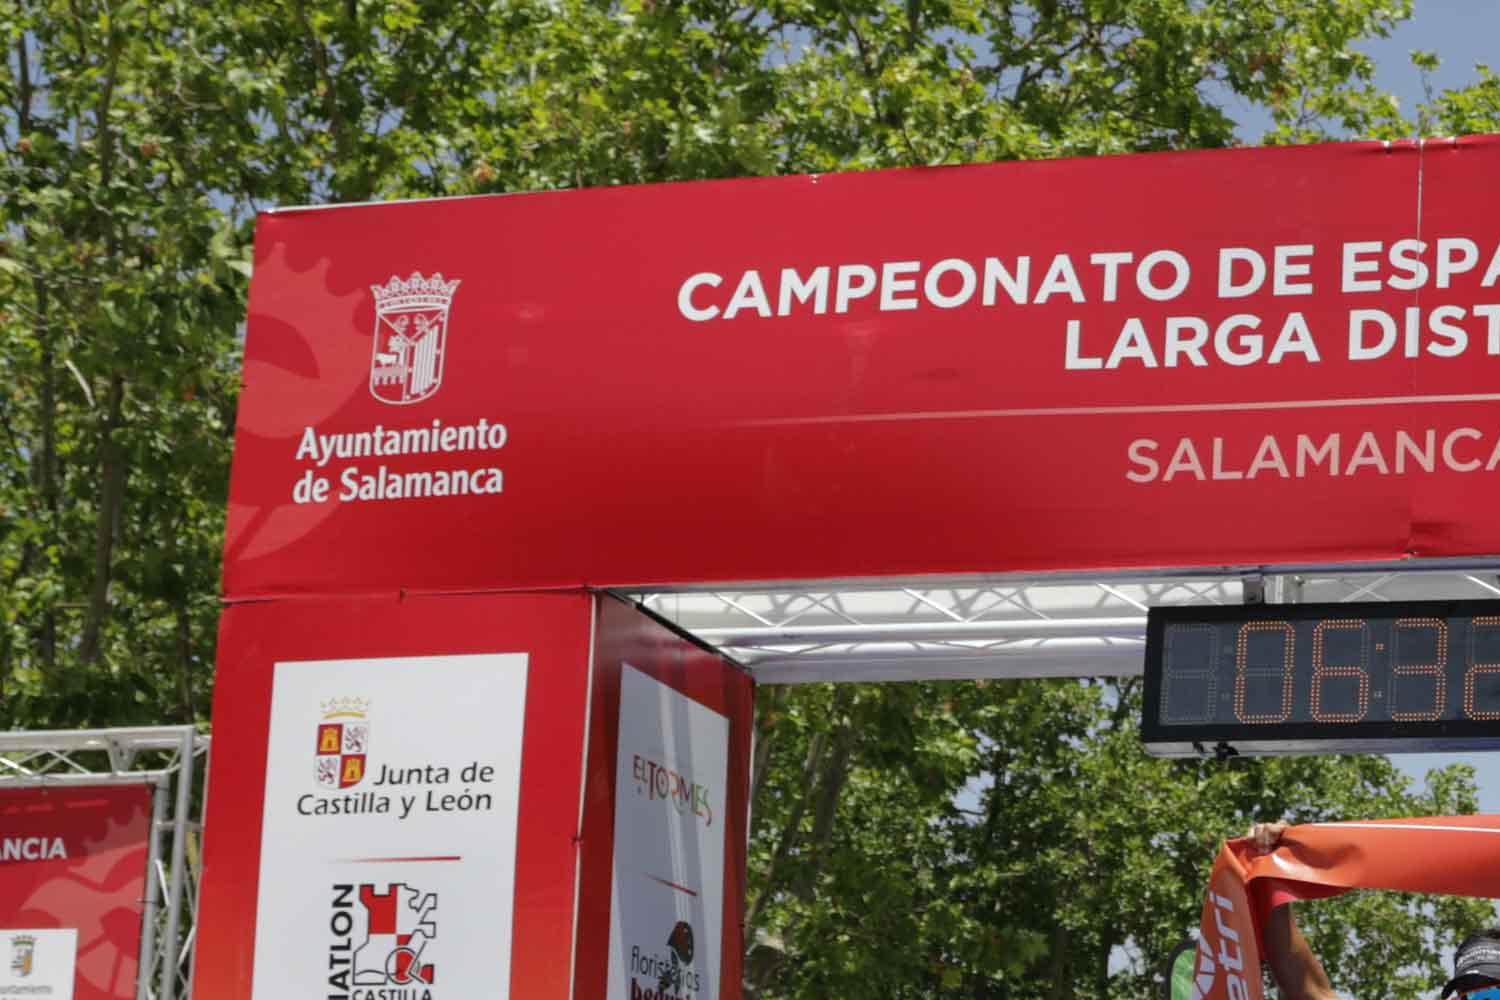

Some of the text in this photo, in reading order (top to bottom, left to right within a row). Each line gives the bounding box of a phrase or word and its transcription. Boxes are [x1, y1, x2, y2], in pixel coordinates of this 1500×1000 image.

[677, 249, 1190, 321] CAMPEONATO
[1217, 244, 1314, 298] DE
[1064, 312, 1320, 370] LARGA
[295, 418, 507, 467] Ayuntamiento
[292, 465, 503, 504] de Salamanca
[373, 762, 494, 786] Junta de
[296, 788, 492, 819] Castilla y León
[0, 836, 67, 860] NCIA
